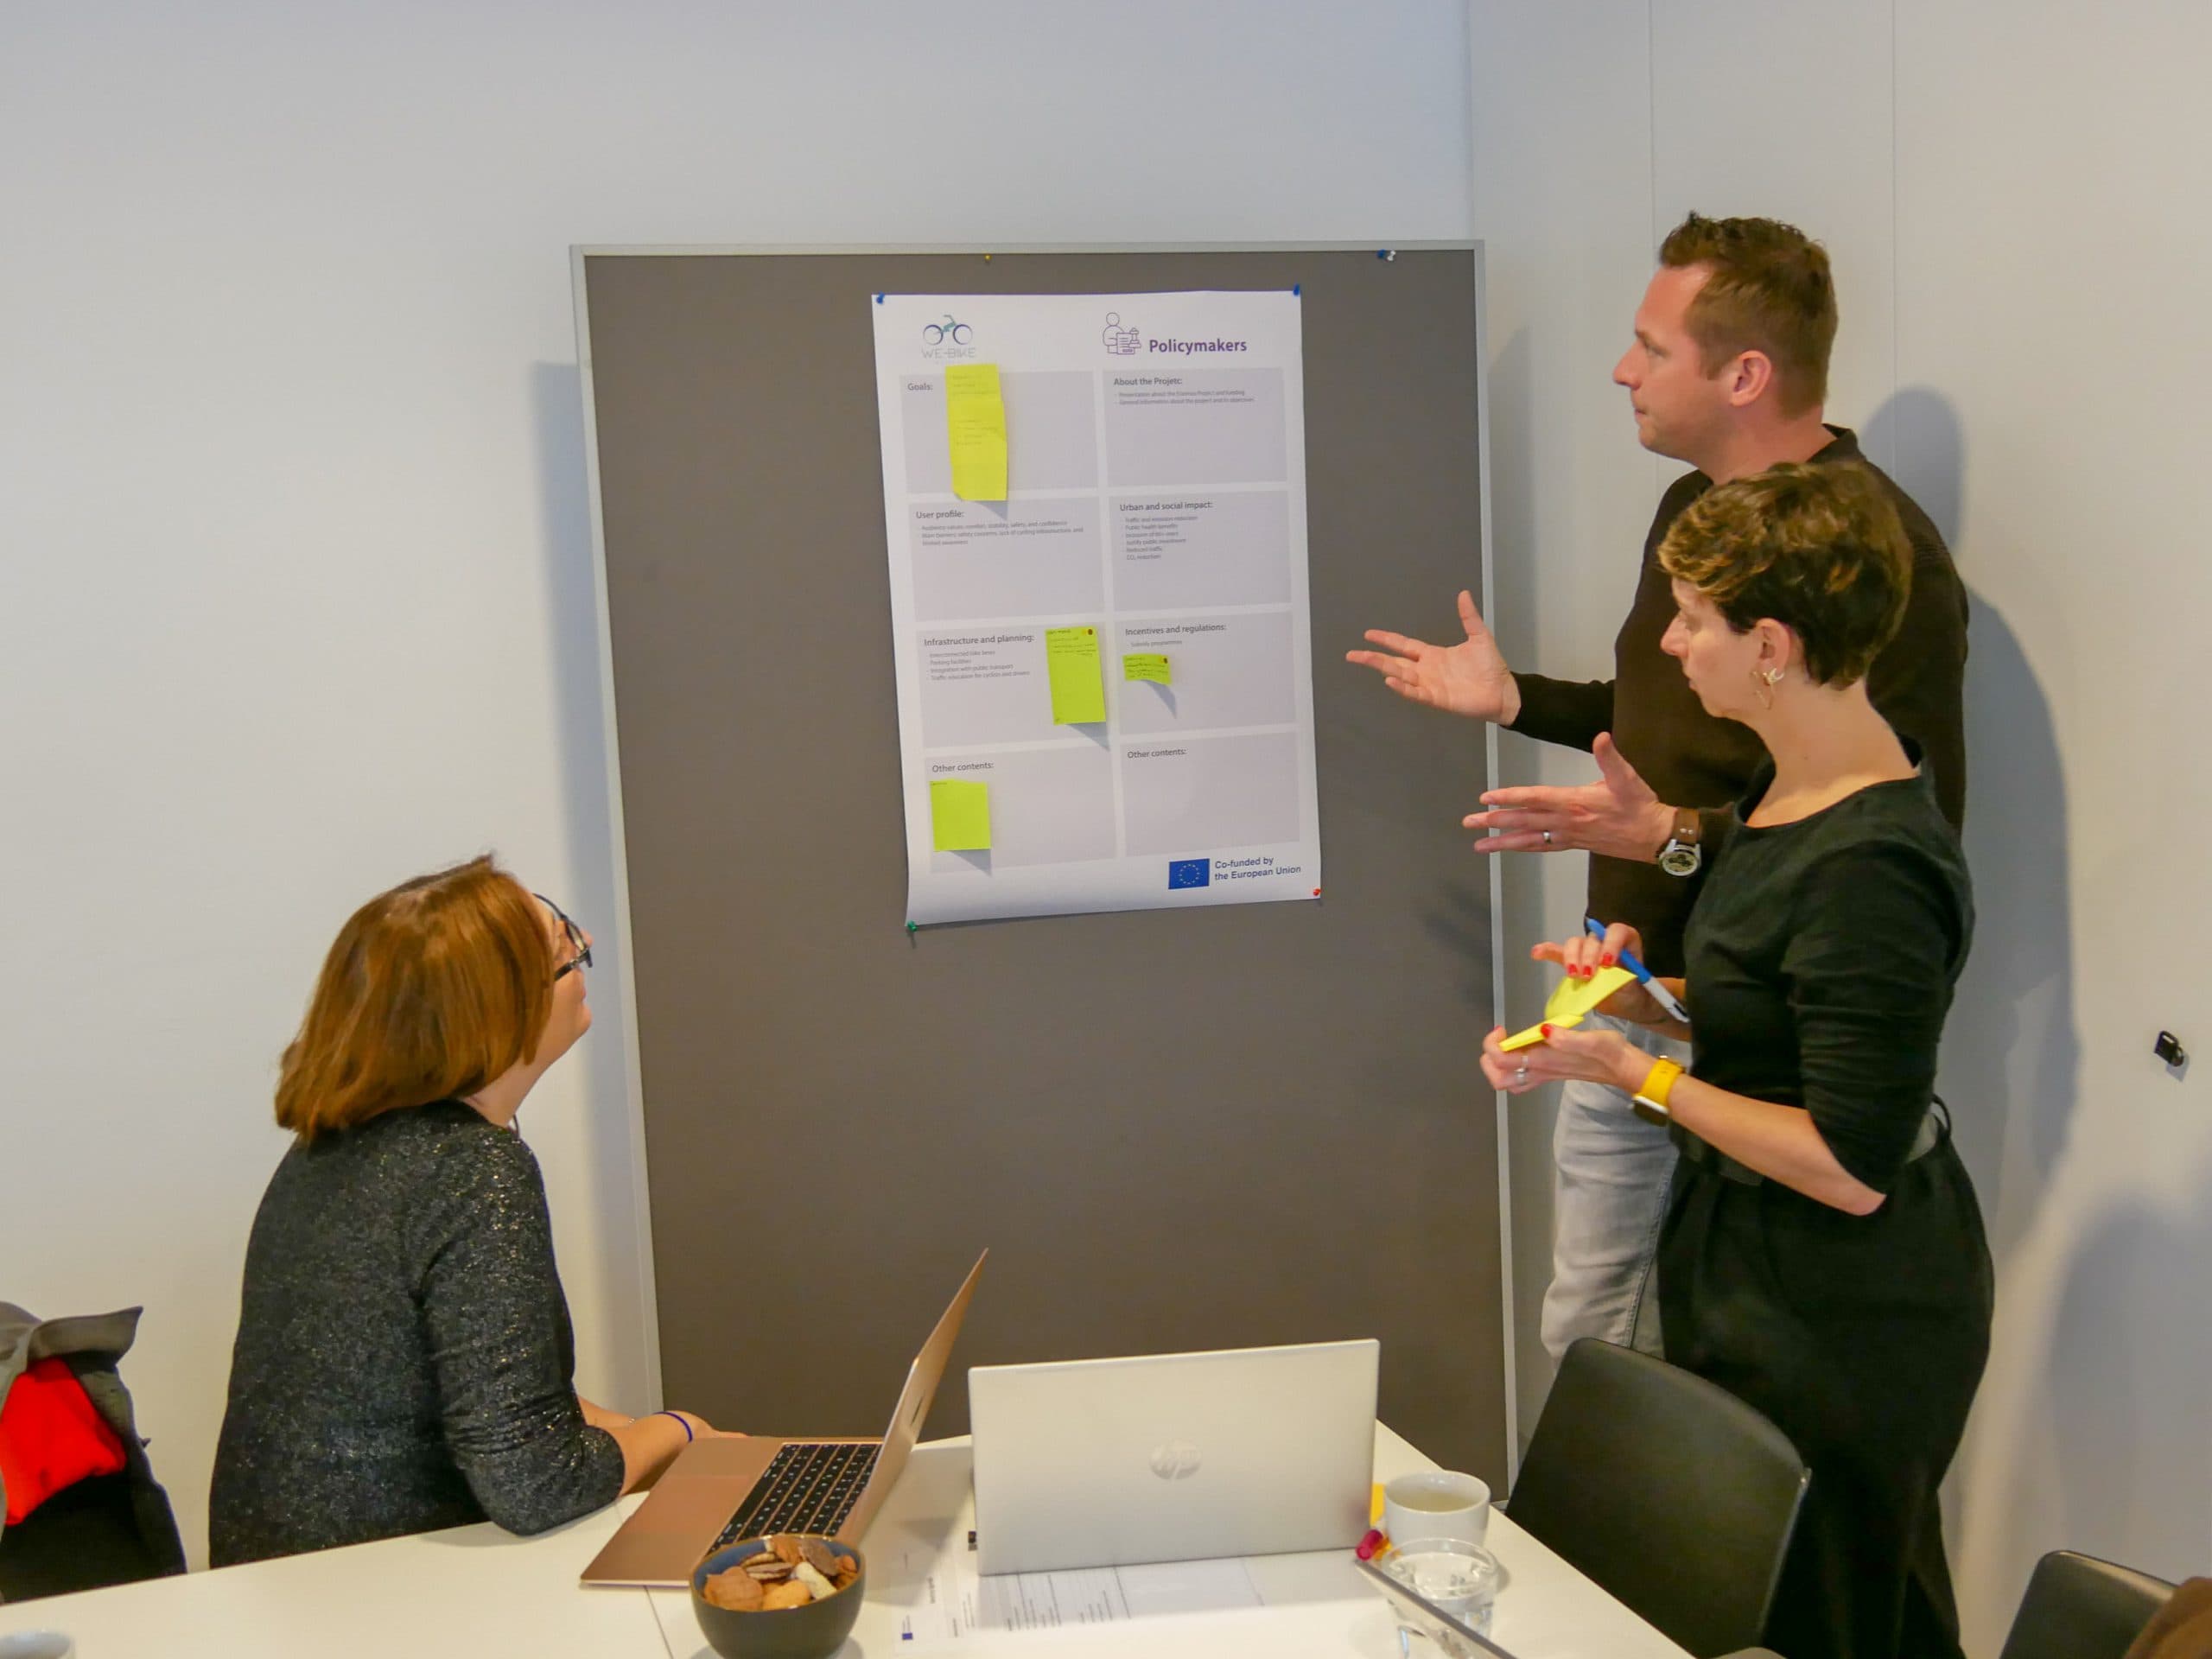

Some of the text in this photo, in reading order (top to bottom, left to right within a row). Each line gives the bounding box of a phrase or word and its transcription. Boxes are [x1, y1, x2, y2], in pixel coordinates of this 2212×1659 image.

[921, 347, 976, 359] WE-BIKE
[1149, 338, 1248, 355] Policymakers
[907, 382, 933, 391] Goals:
[1146, 502, 1160, 511] and
[1161, 501, 1183, 510] social
[1185, 501, 1214, 511] impact:
[916, 509, 965, 520] User profile:
[1125, 623, 1227, 637] Incentives and regulations:
[924, 633, 1035, 646] Infrastructure and planning:
[1127, 747, 1188, 759] Other contents:
[931, 760, 995, 773] Other contents:
[1215, 856, 1274, 869] Co-funded by
[1215, 865, 1301, 880] the European Union
